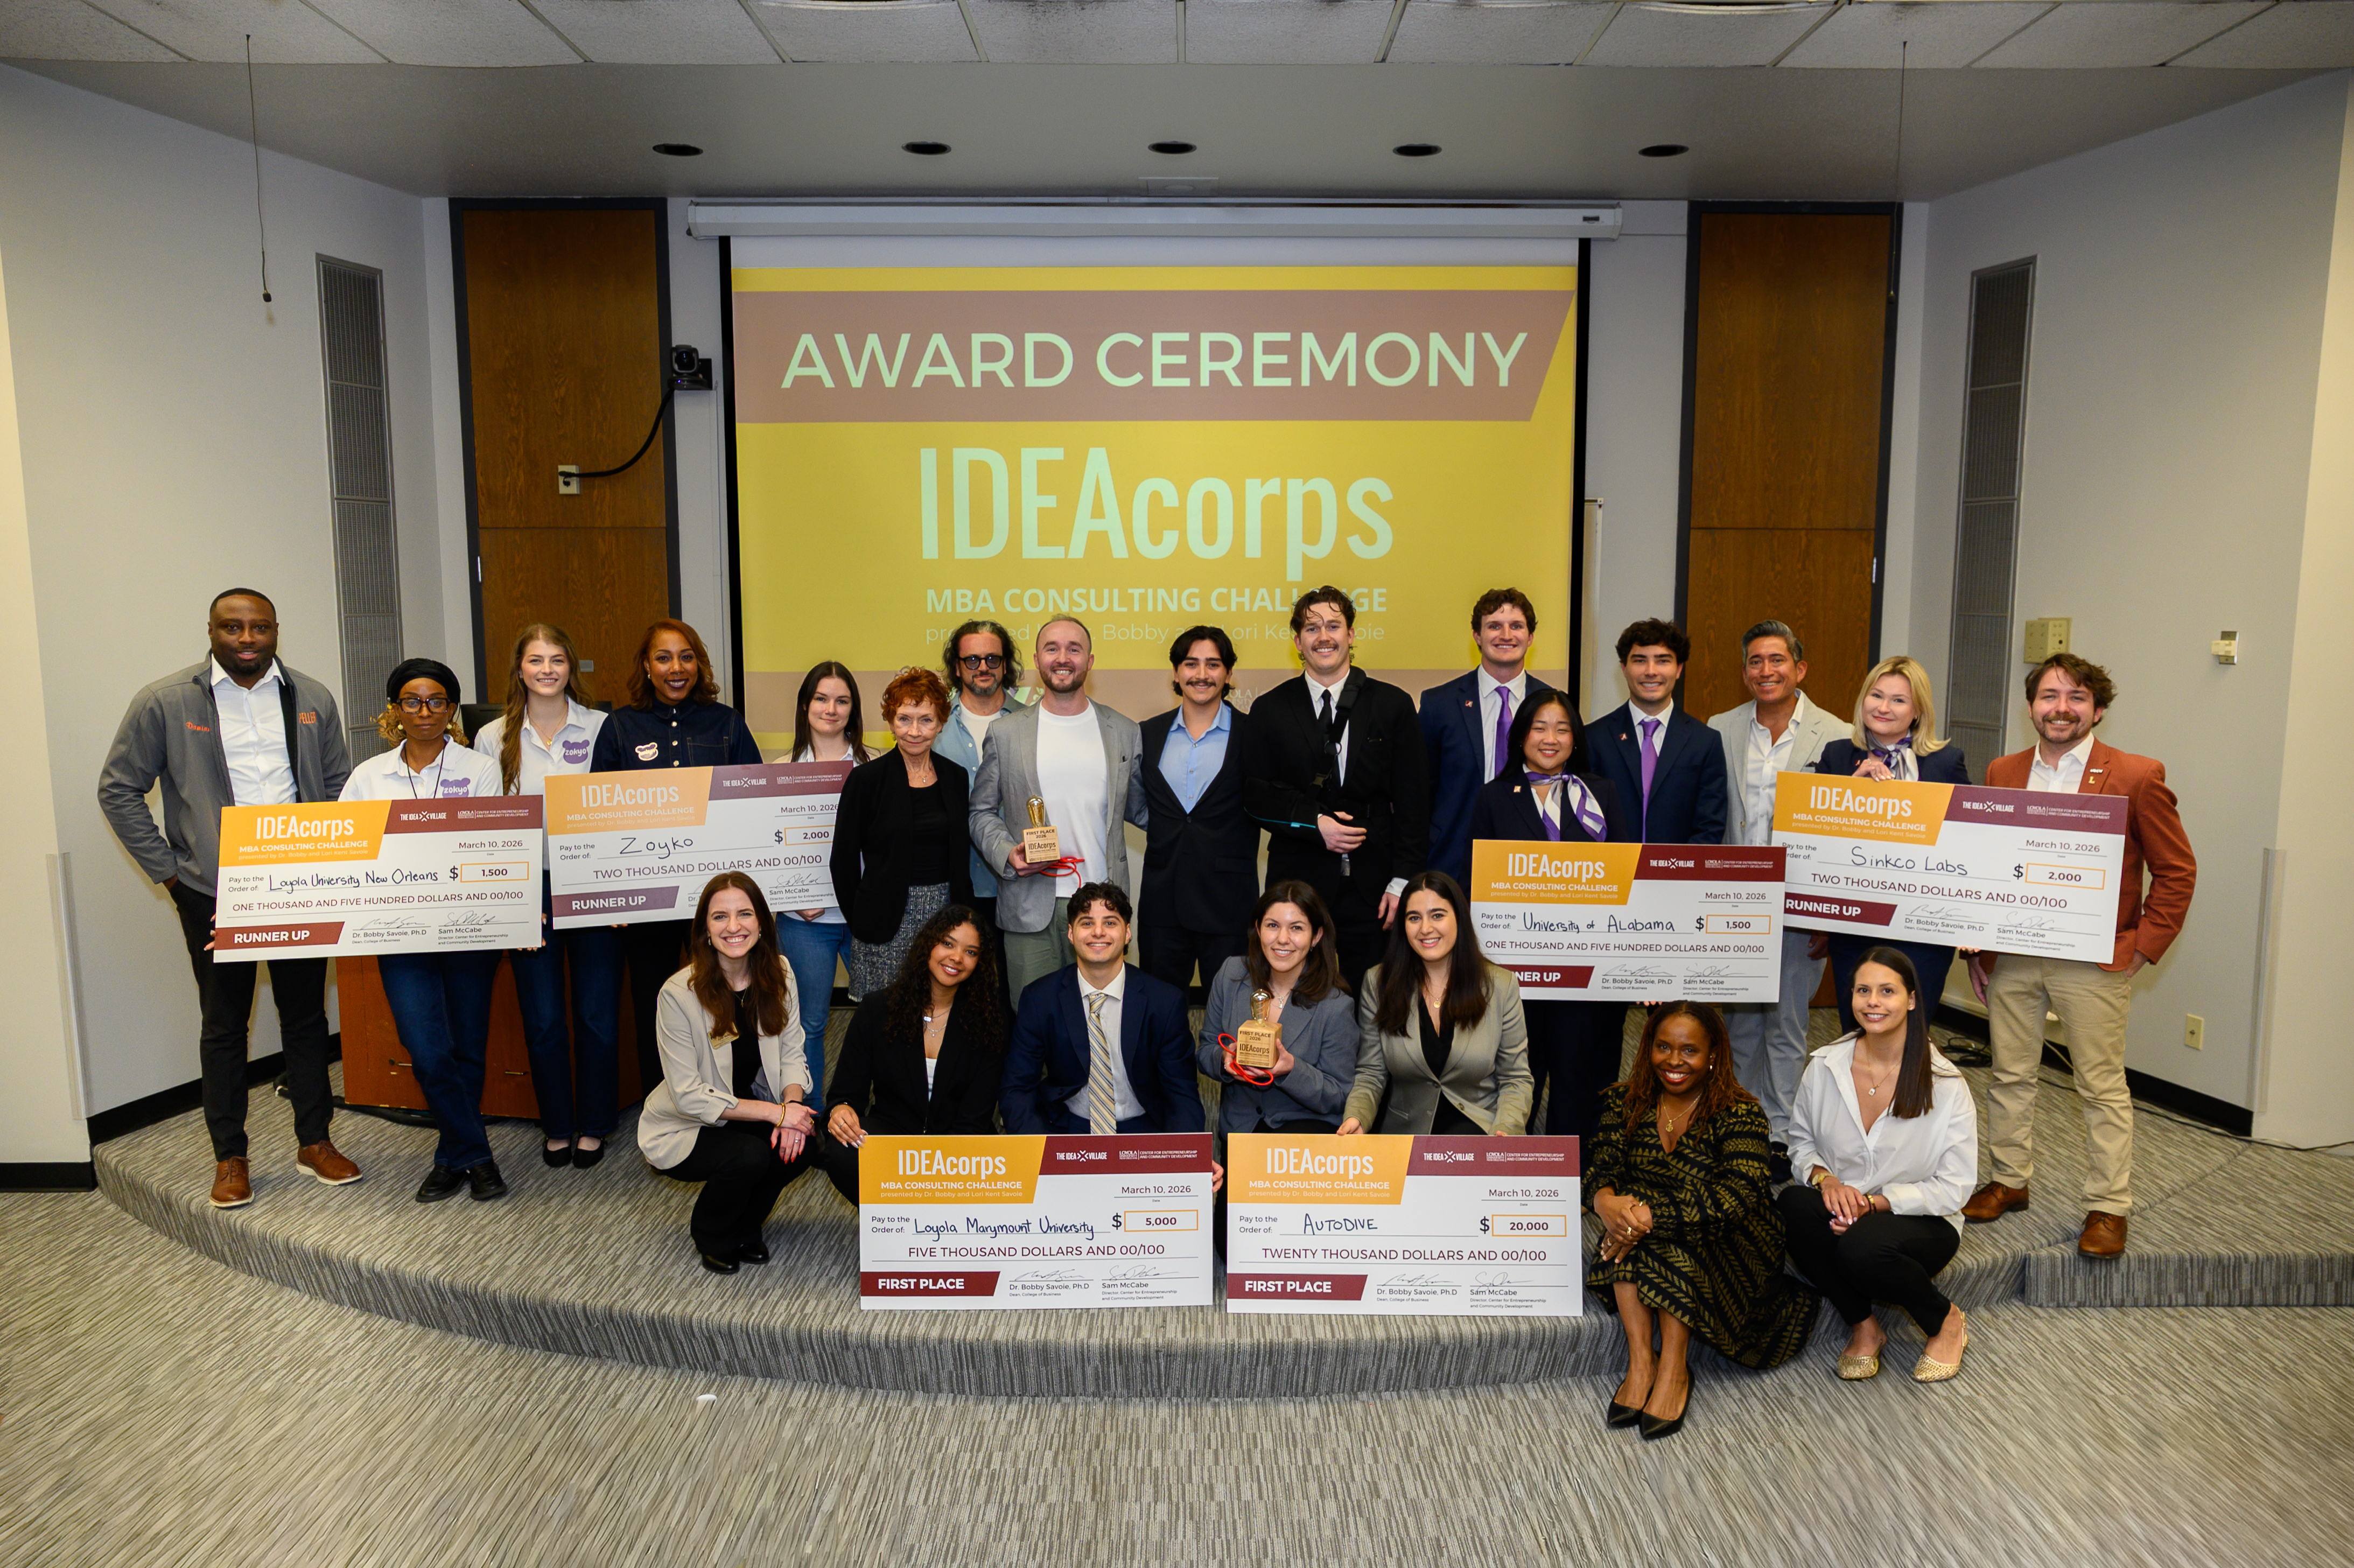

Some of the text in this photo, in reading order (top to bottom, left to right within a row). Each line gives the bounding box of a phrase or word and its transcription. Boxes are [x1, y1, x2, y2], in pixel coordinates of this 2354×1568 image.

[782, 332, 1527, 388] AWARD CEREMONY
[921, 447, 1392, 581] IDEAcorps
[927, 589, 995, 612] MBA
[1003, 588, 1201, 612] CONSULTING
[1103, 625, 1169, 643] Bobby
[565, 746, 587, 757] zokyo
[444, 785, 467, 795] zokyo
[582, 784, 679, 807] IDEAcorps
[1807, 786, 1912, 821] IDEAcorps
[589, 810, 642, 819] CONSULTING
[645, 807, 693, 816] CHALLENGE
[257, 816, 353, 840] IDEAcorps
[1814, 815, 1872, 828] CONSULTING
[1872, 821, 1926, 831] CHALLENGE
[775, 830, 829, 844] $ 2,000
[261, 843, 314, 851] CONSULTING
[317, 841, 368, 849] CHALLENGE
[2026, 840, 2056, 848] March
[2075, 844, 2100, 852] 2026
[450, 866, 458, 881] $
[593, 855, 824, 879] TWO THOUSAND DOLLARS AND 00/100
[1508, 853, 1605, 883] IDEAcorps
[1925, 857, 1967, 876] Labs
[2013, 864, 2081, 881] $ 2,000
[270, 869, 438, 894] Loyola University New Orleans
[1812, 873, 2067, 908] TWO THOUSAND DOLLARS AND 00/100
[257, 901, 312, 909] THOUSAND
[365, 896, 415, 905] HUNDRED
[418, 894, 463, 902] DOLLARS
[491, 891, 523, 900] 00/100
[572, 896, 646, 909] RUNNER UP
[1786, 899, 1861, 916] RUNNER UP
[1524, 912, 1580, 934] University
[1587, 920, 1595, 929] of
[1696, 916, 1704, 932] $
[235, 930, 310, 943] RUNNER UP
[1543, 972, 1561, 982] UP
[1240, 1044, 1269, 1054] IDEAcorps
[899, 1150, 1006, 1179] IDEAcorps
[1267, 1149, 1373, 1179] IDEAcorps
[915, 1219, 957, 1242] Loyola
[1040, 1216, 1094, 1241] University
[1112, 1213, 1176, 1230] $ 5,000
[1480, 1216, 1548, 1234] $ 20,000
[909, 1244, 1164, 1257] FIVE THOUSAND DOLLARS AND 00/100
[1262, 1249, 1546, 1262] TWENTY THOUSAND DOLLARS AND 00/100
[879, 1279, 964, 1289] FIRST PLACE
[1245, 1281, 1332, 1292] FIRST PLACE
